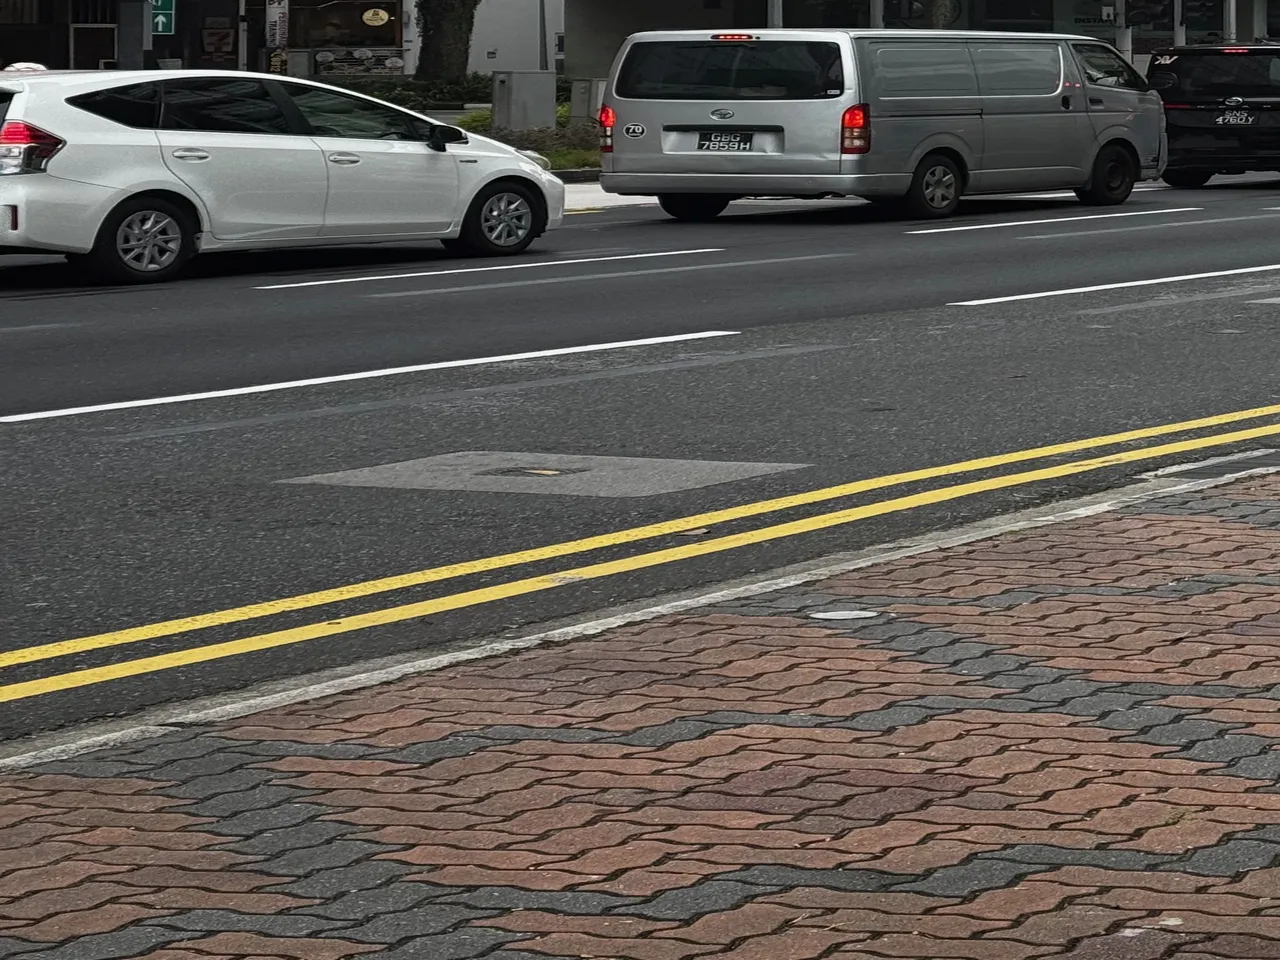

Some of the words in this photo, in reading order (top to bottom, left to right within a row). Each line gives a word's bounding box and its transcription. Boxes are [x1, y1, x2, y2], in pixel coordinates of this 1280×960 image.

[628, 125, 642, 134] 70
[711, 132, 740, 141] GBG
[700, 141, 750, 150] 7859H
